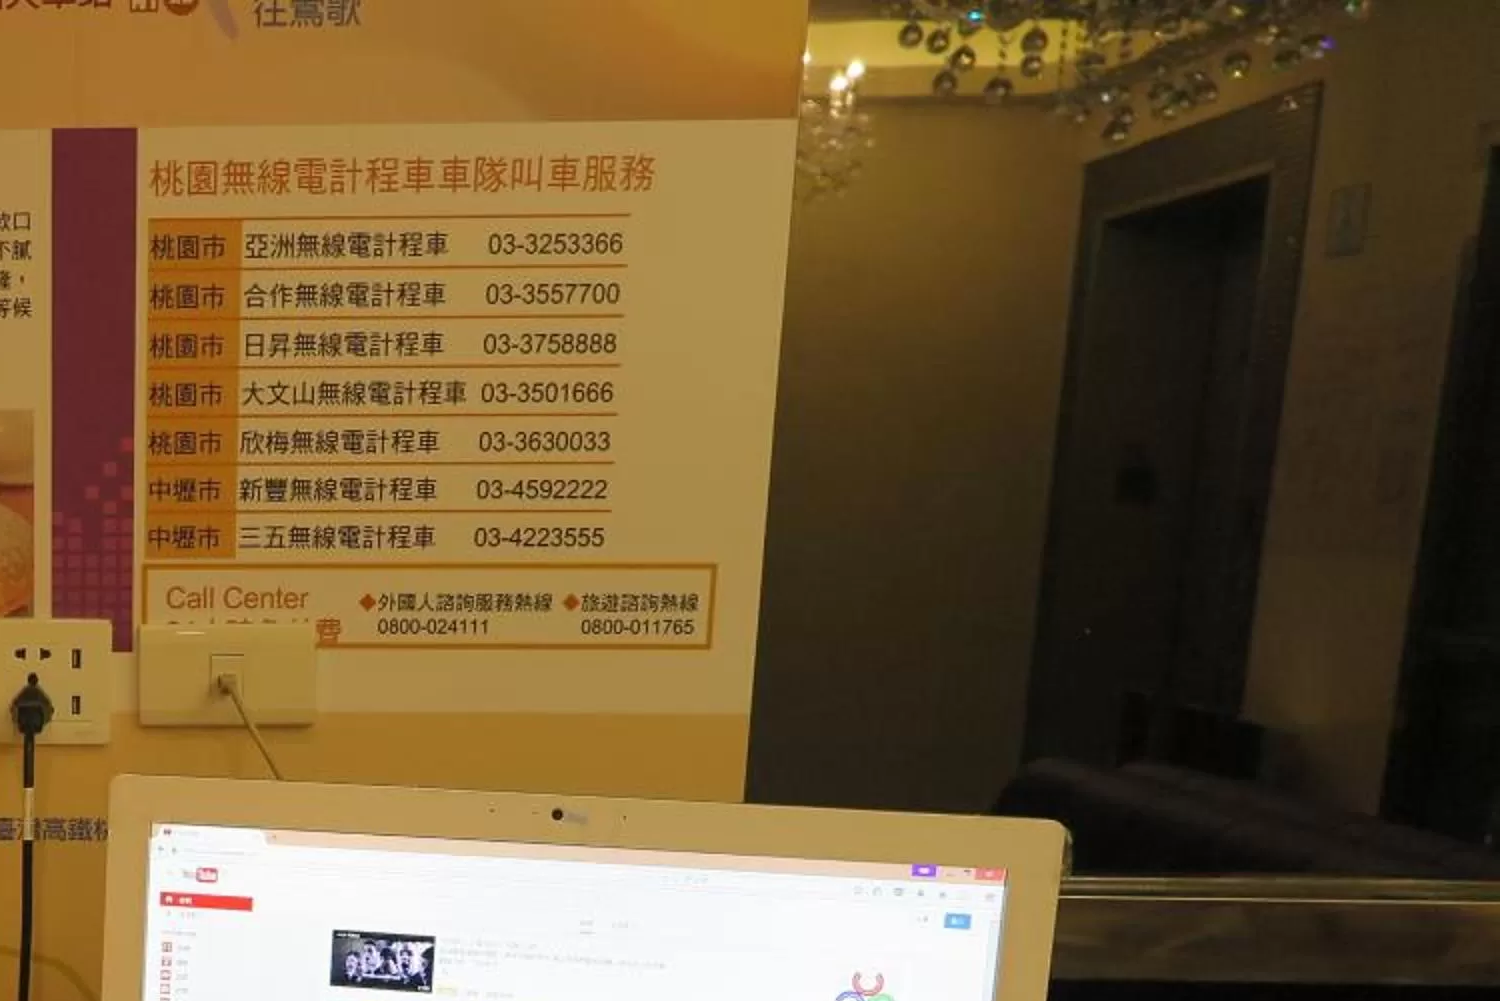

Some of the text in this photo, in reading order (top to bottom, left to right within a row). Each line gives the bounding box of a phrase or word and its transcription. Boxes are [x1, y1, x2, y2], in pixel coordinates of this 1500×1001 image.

[148, 155, 656, 196] 桃園無線電計程車車隊叫車服務
[150, 231, 623, 261] 桃園市 亞洲無線電計程車 03-3253366
[149, 281, 620, 310] 桃園市 合作無線電計程車 03-3557700
[148, 331, 617, 360] 桃園市 日昇無線電計程車 03-3758888
[148, 380, 614, 409] 桃園市 大文山無線電計程車 03-3501666
[148, 429, 611, 456] 桃園市 欣梅無線電計程車 03-3630033
[148, 477, 607, 503] 中壢市 新豐無線電計程車 03-4592222
[147, 525, 605, 551] 中壢市 三五無線電計程車 03-4223555
[166, 586, 309, 610] Call Center
[377, 593, 699, 613] 外國人諮詢服務熱線 旅遊諮詢熱線
[377, 619, 695, 637] 0800-024111 0800-011765
